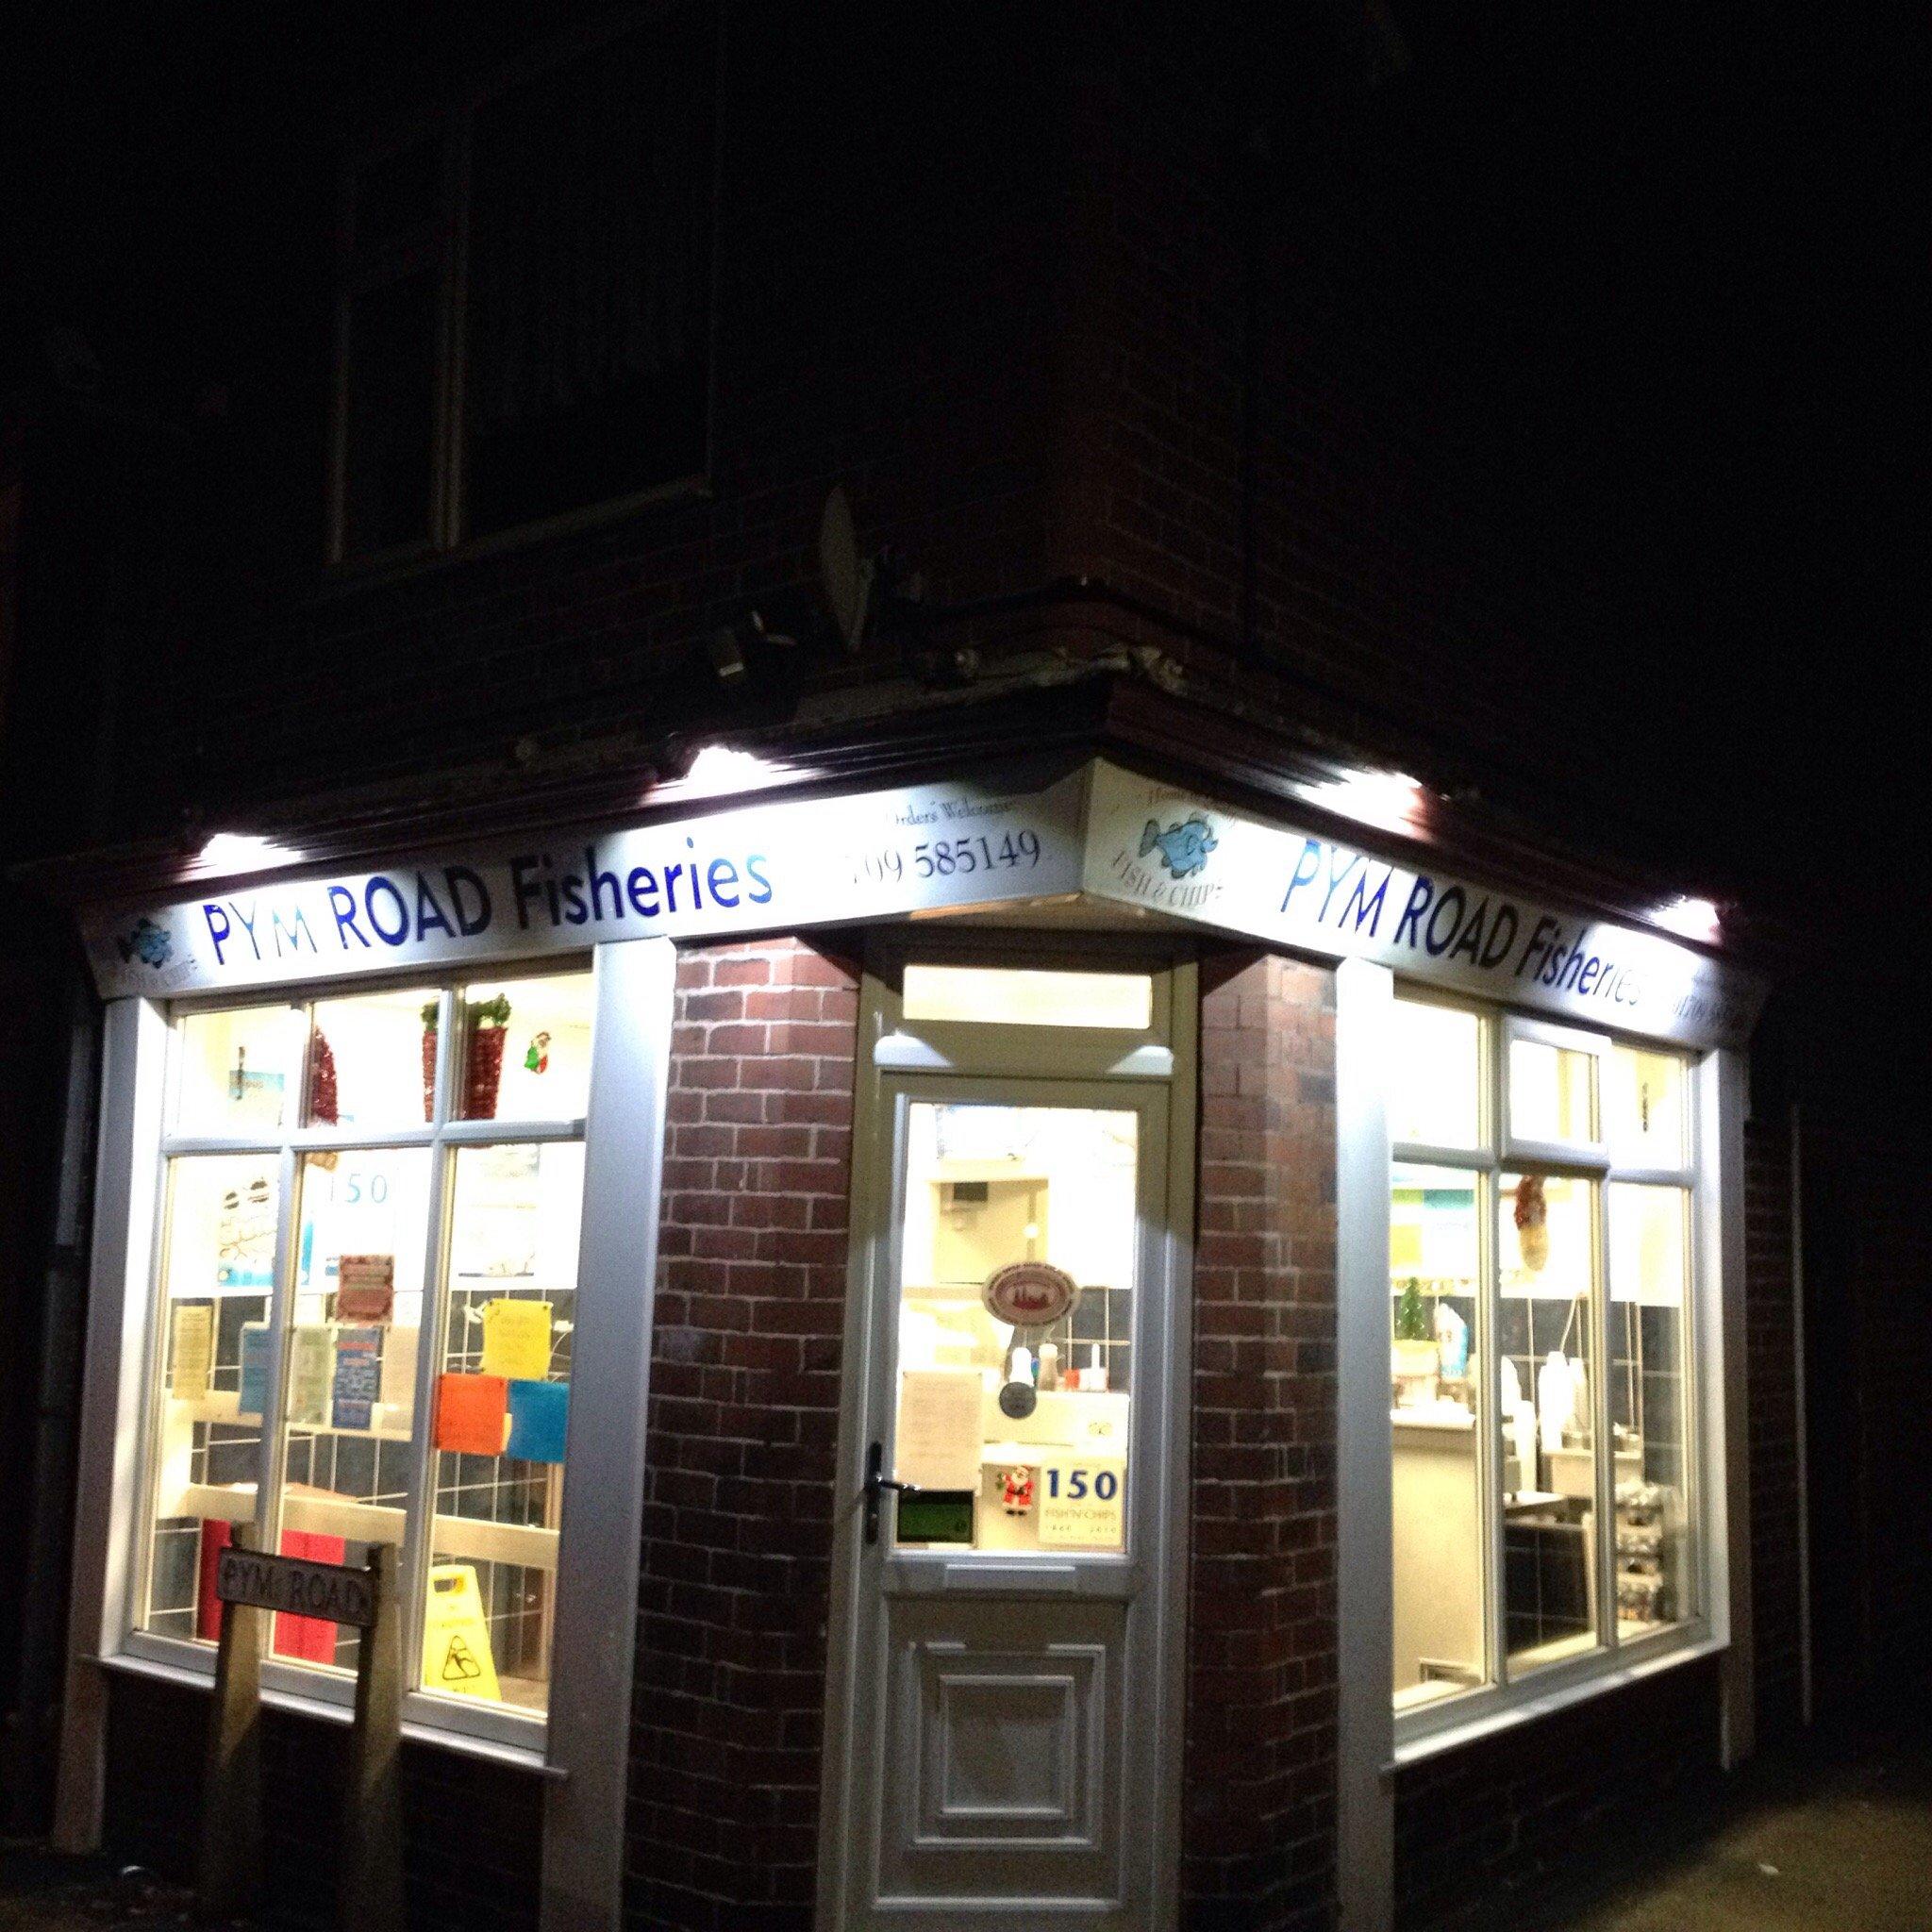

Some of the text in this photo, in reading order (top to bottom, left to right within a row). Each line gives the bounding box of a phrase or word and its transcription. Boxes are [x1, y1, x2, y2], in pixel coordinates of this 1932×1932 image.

[914, 828, 1041, 878] 585149
[202, 836, 774, 966] PYM ROAD Fisheries
[1280, 839, 1396, 938] PYM
[1393, 874, 1519, 971] ROAD
[1047, 1468, 1118, 1500] 150
